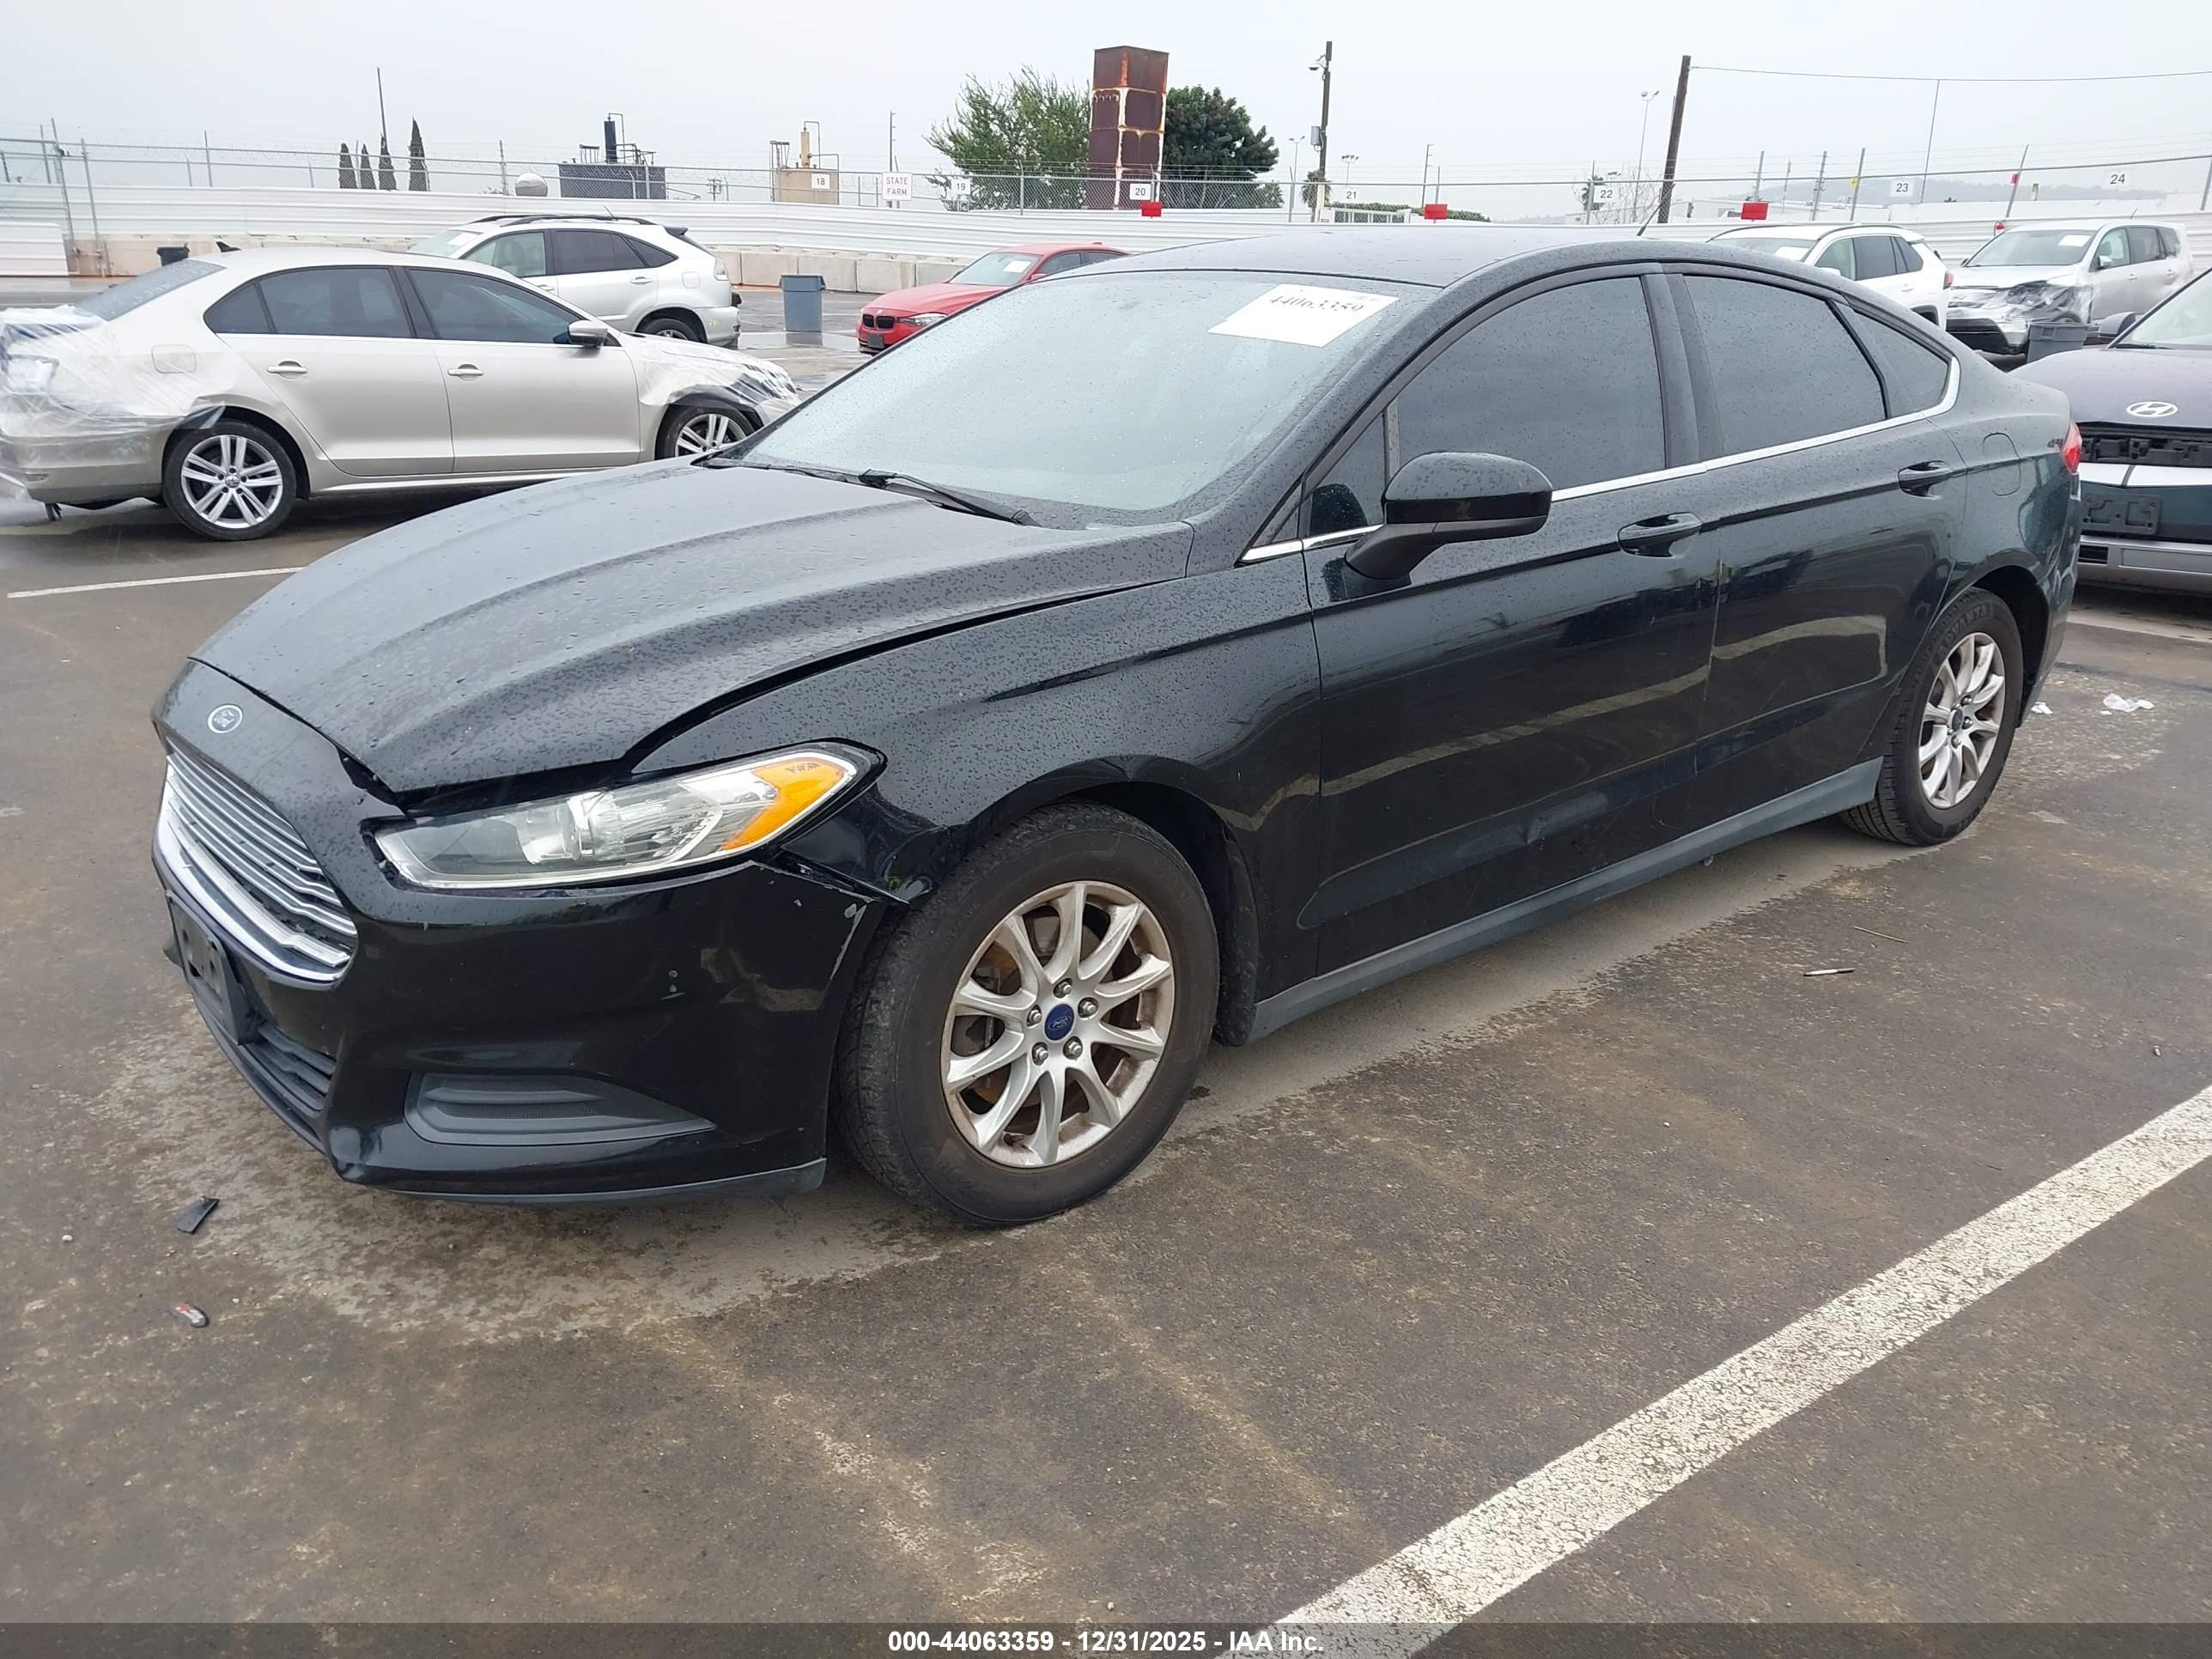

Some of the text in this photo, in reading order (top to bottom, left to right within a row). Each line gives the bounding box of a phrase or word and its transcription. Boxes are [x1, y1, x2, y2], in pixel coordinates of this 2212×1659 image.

[817, 177, 825, 186] 18
[885, 176, 908, 185] STATE
[2110, 173, 2125, 185] 24
[957, 182, 966, 191] 19
[1896, 182, 1909, 192] 23
[886, 187, 908, 197] FARM
[1134, 187, 1146, 196] 20
[1346, 191, 1357, 200] 21
[1600, 190, 1613, 198] 22
